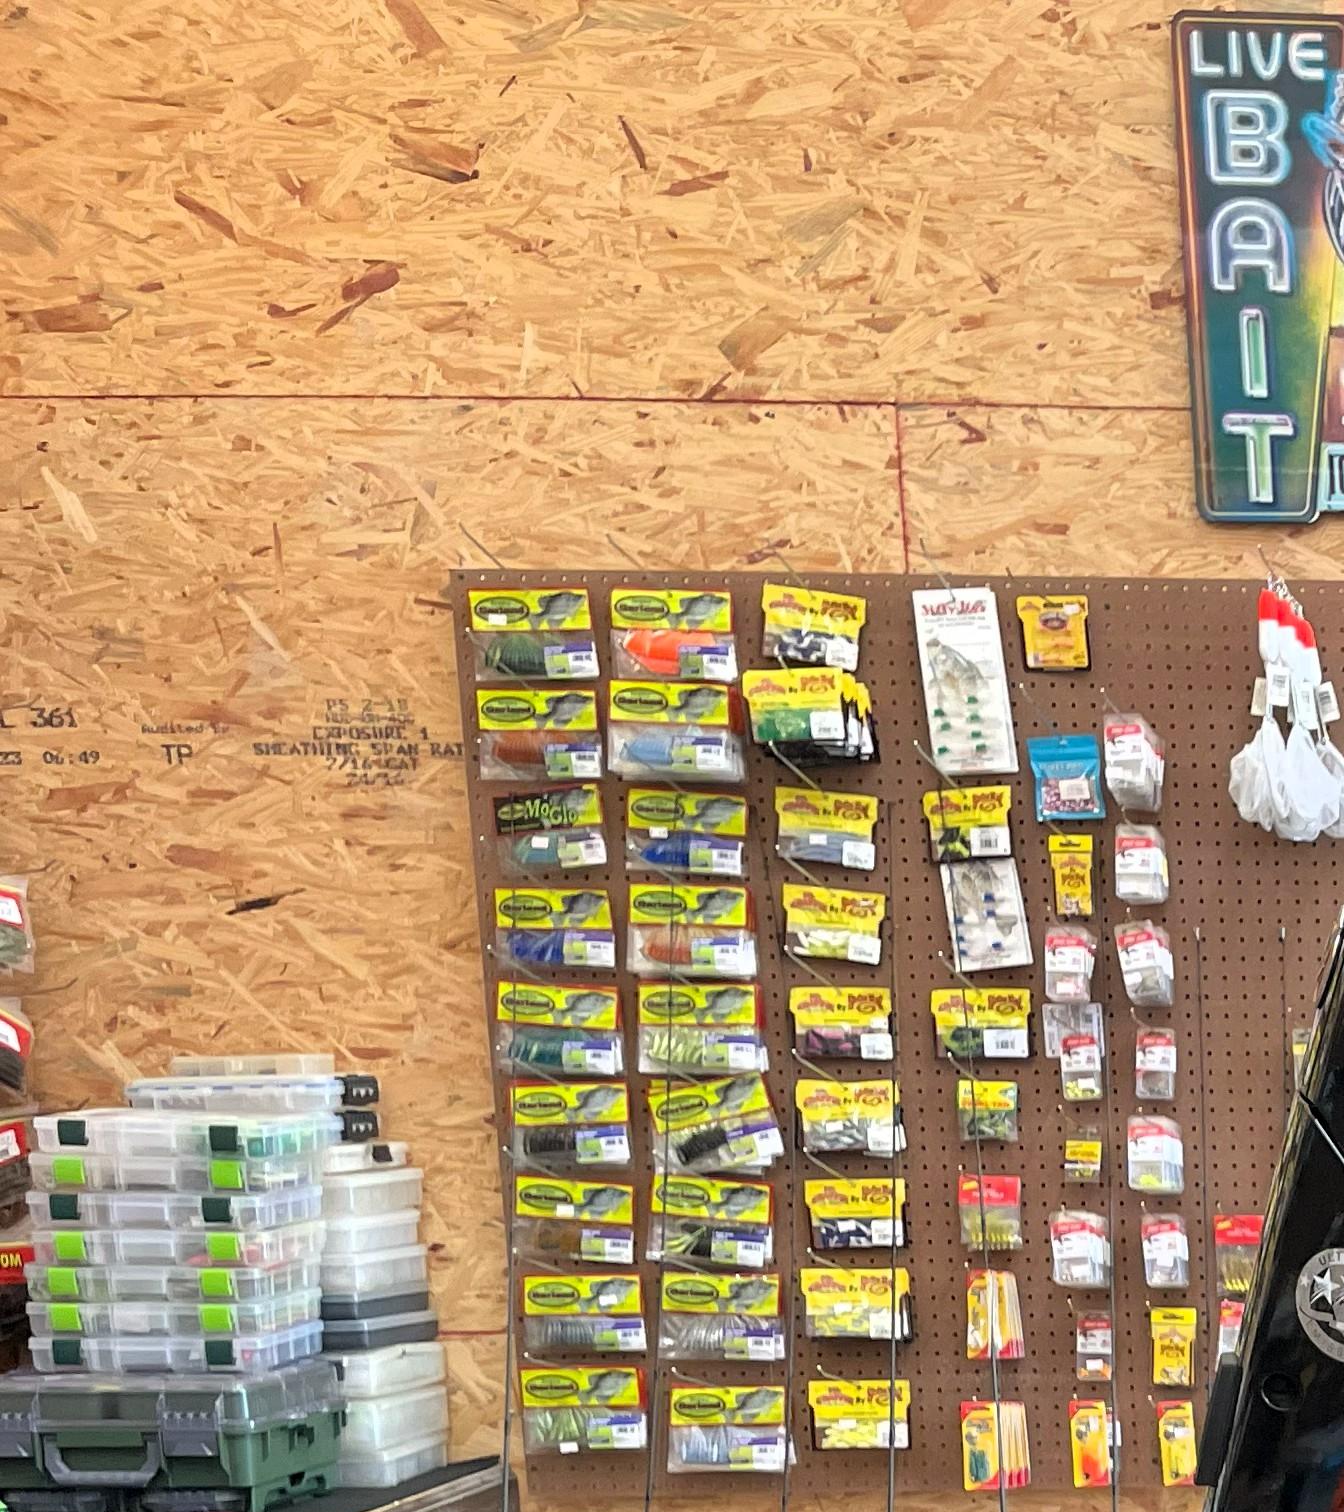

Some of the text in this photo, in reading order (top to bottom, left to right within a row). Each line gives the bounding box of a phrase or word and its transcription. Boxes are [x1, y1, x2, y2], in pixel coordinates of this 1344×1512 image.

[1189, 31, 1326, 80] LIVE
[1207, 89, 1295, 505] BAIT
[30, 707, 79, 729] 361
[312, 726, 408, 740] EXPOSURE
[161, 743, 194, 766] TP
[252, 741, 361, 757] SHEATHING
[370, 741, 420, 756] SPAN
